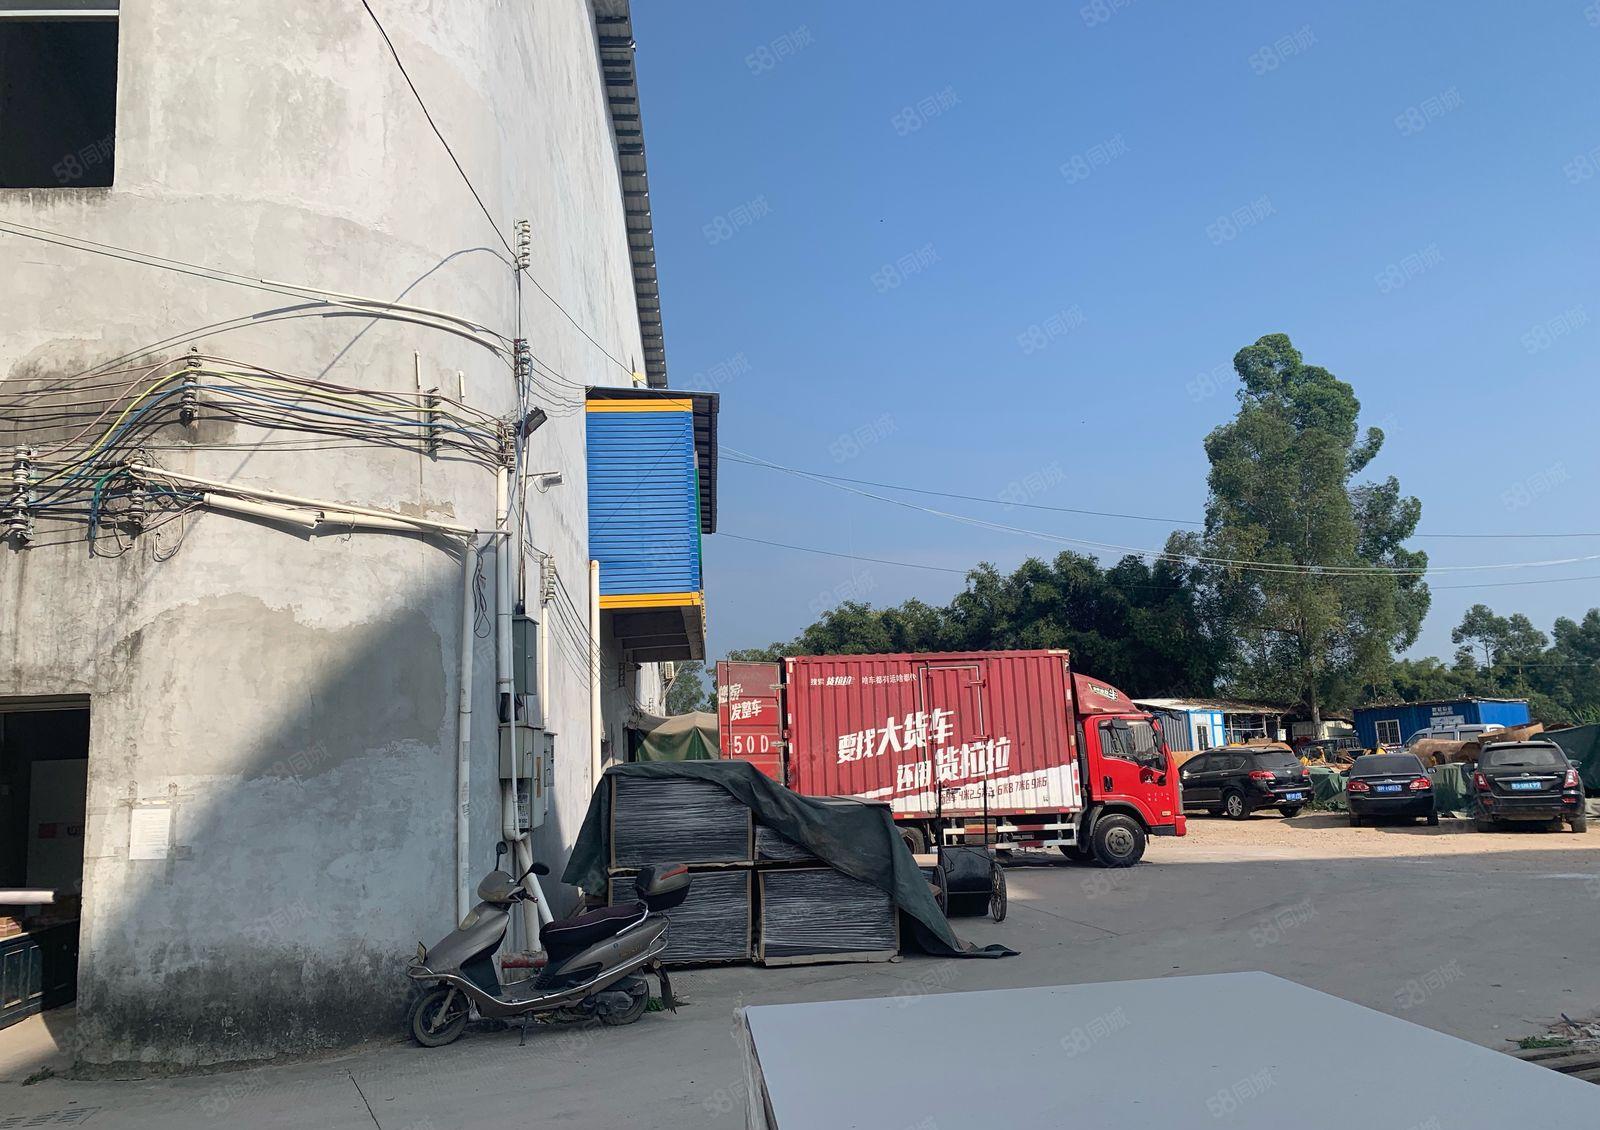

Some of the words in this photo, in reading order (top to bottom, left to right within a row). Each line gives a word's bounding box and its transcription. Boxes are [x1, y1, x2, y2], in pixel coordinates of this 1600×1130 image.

[731, 699, 762, 721] 发整车
[837, 708, 954, 764] 要找大货车
[896, 736, 1011, 793] 还用货拉拉
